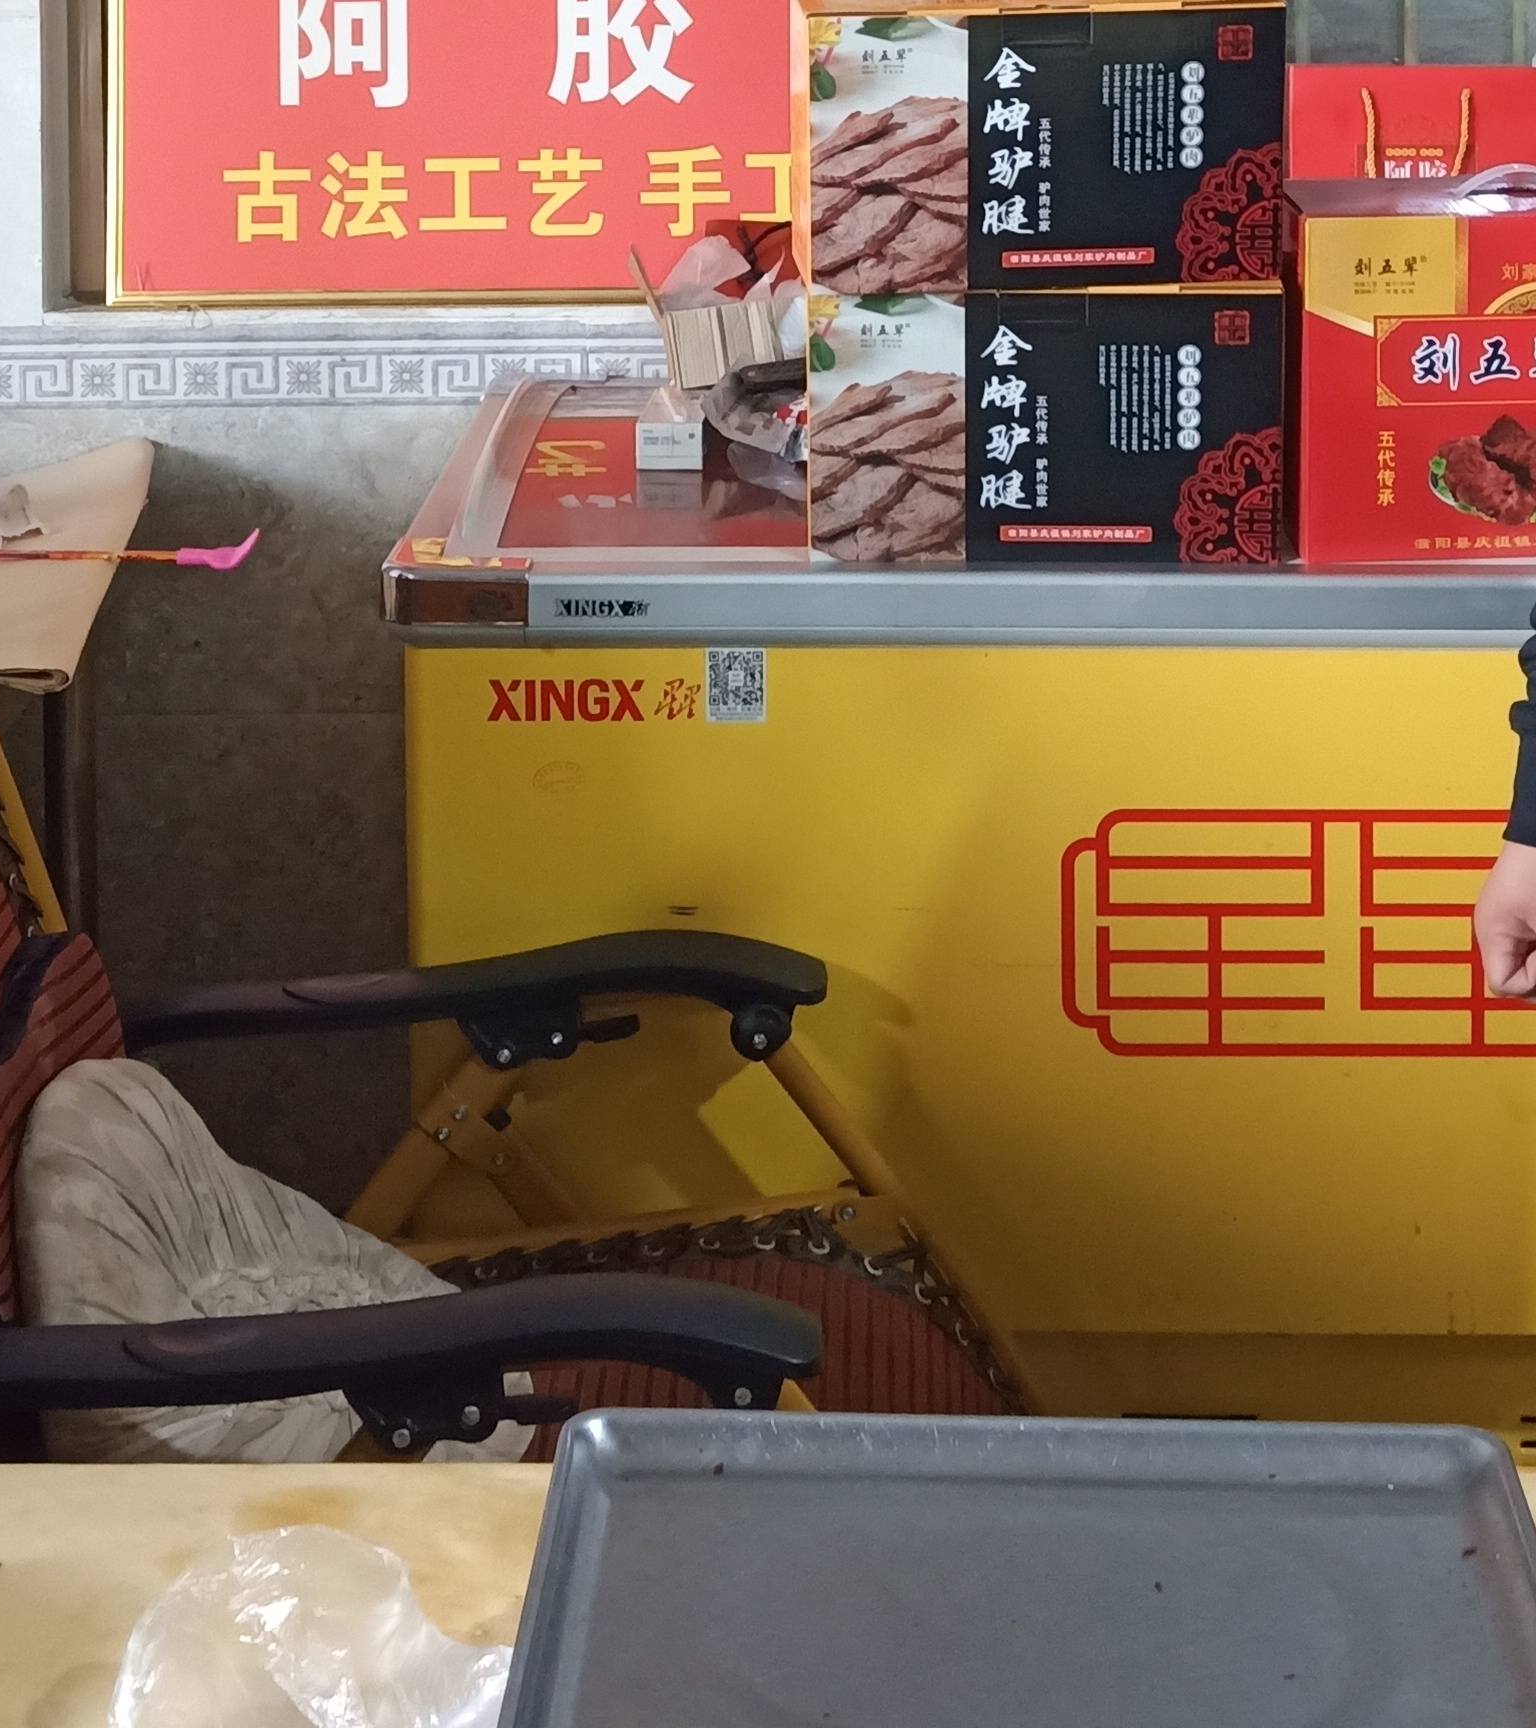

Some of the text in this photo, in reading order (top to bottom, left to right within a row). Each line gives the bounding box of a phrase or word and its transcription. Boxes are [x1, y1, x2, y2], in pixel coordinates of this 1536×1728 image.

[982, 47, 1036, 235] 金牌驴腱
[1038, 118, 1052, 169] 五代传承
[224, 148, 604, 242] 古法工艺
[980, 325, 1032, 509] 金牌驴腱
[1035, 395, 1048, 445] 五代传承
[1377, 430, 1396, 507] 五代传承
[487, 678, 645, 722] XINGX
